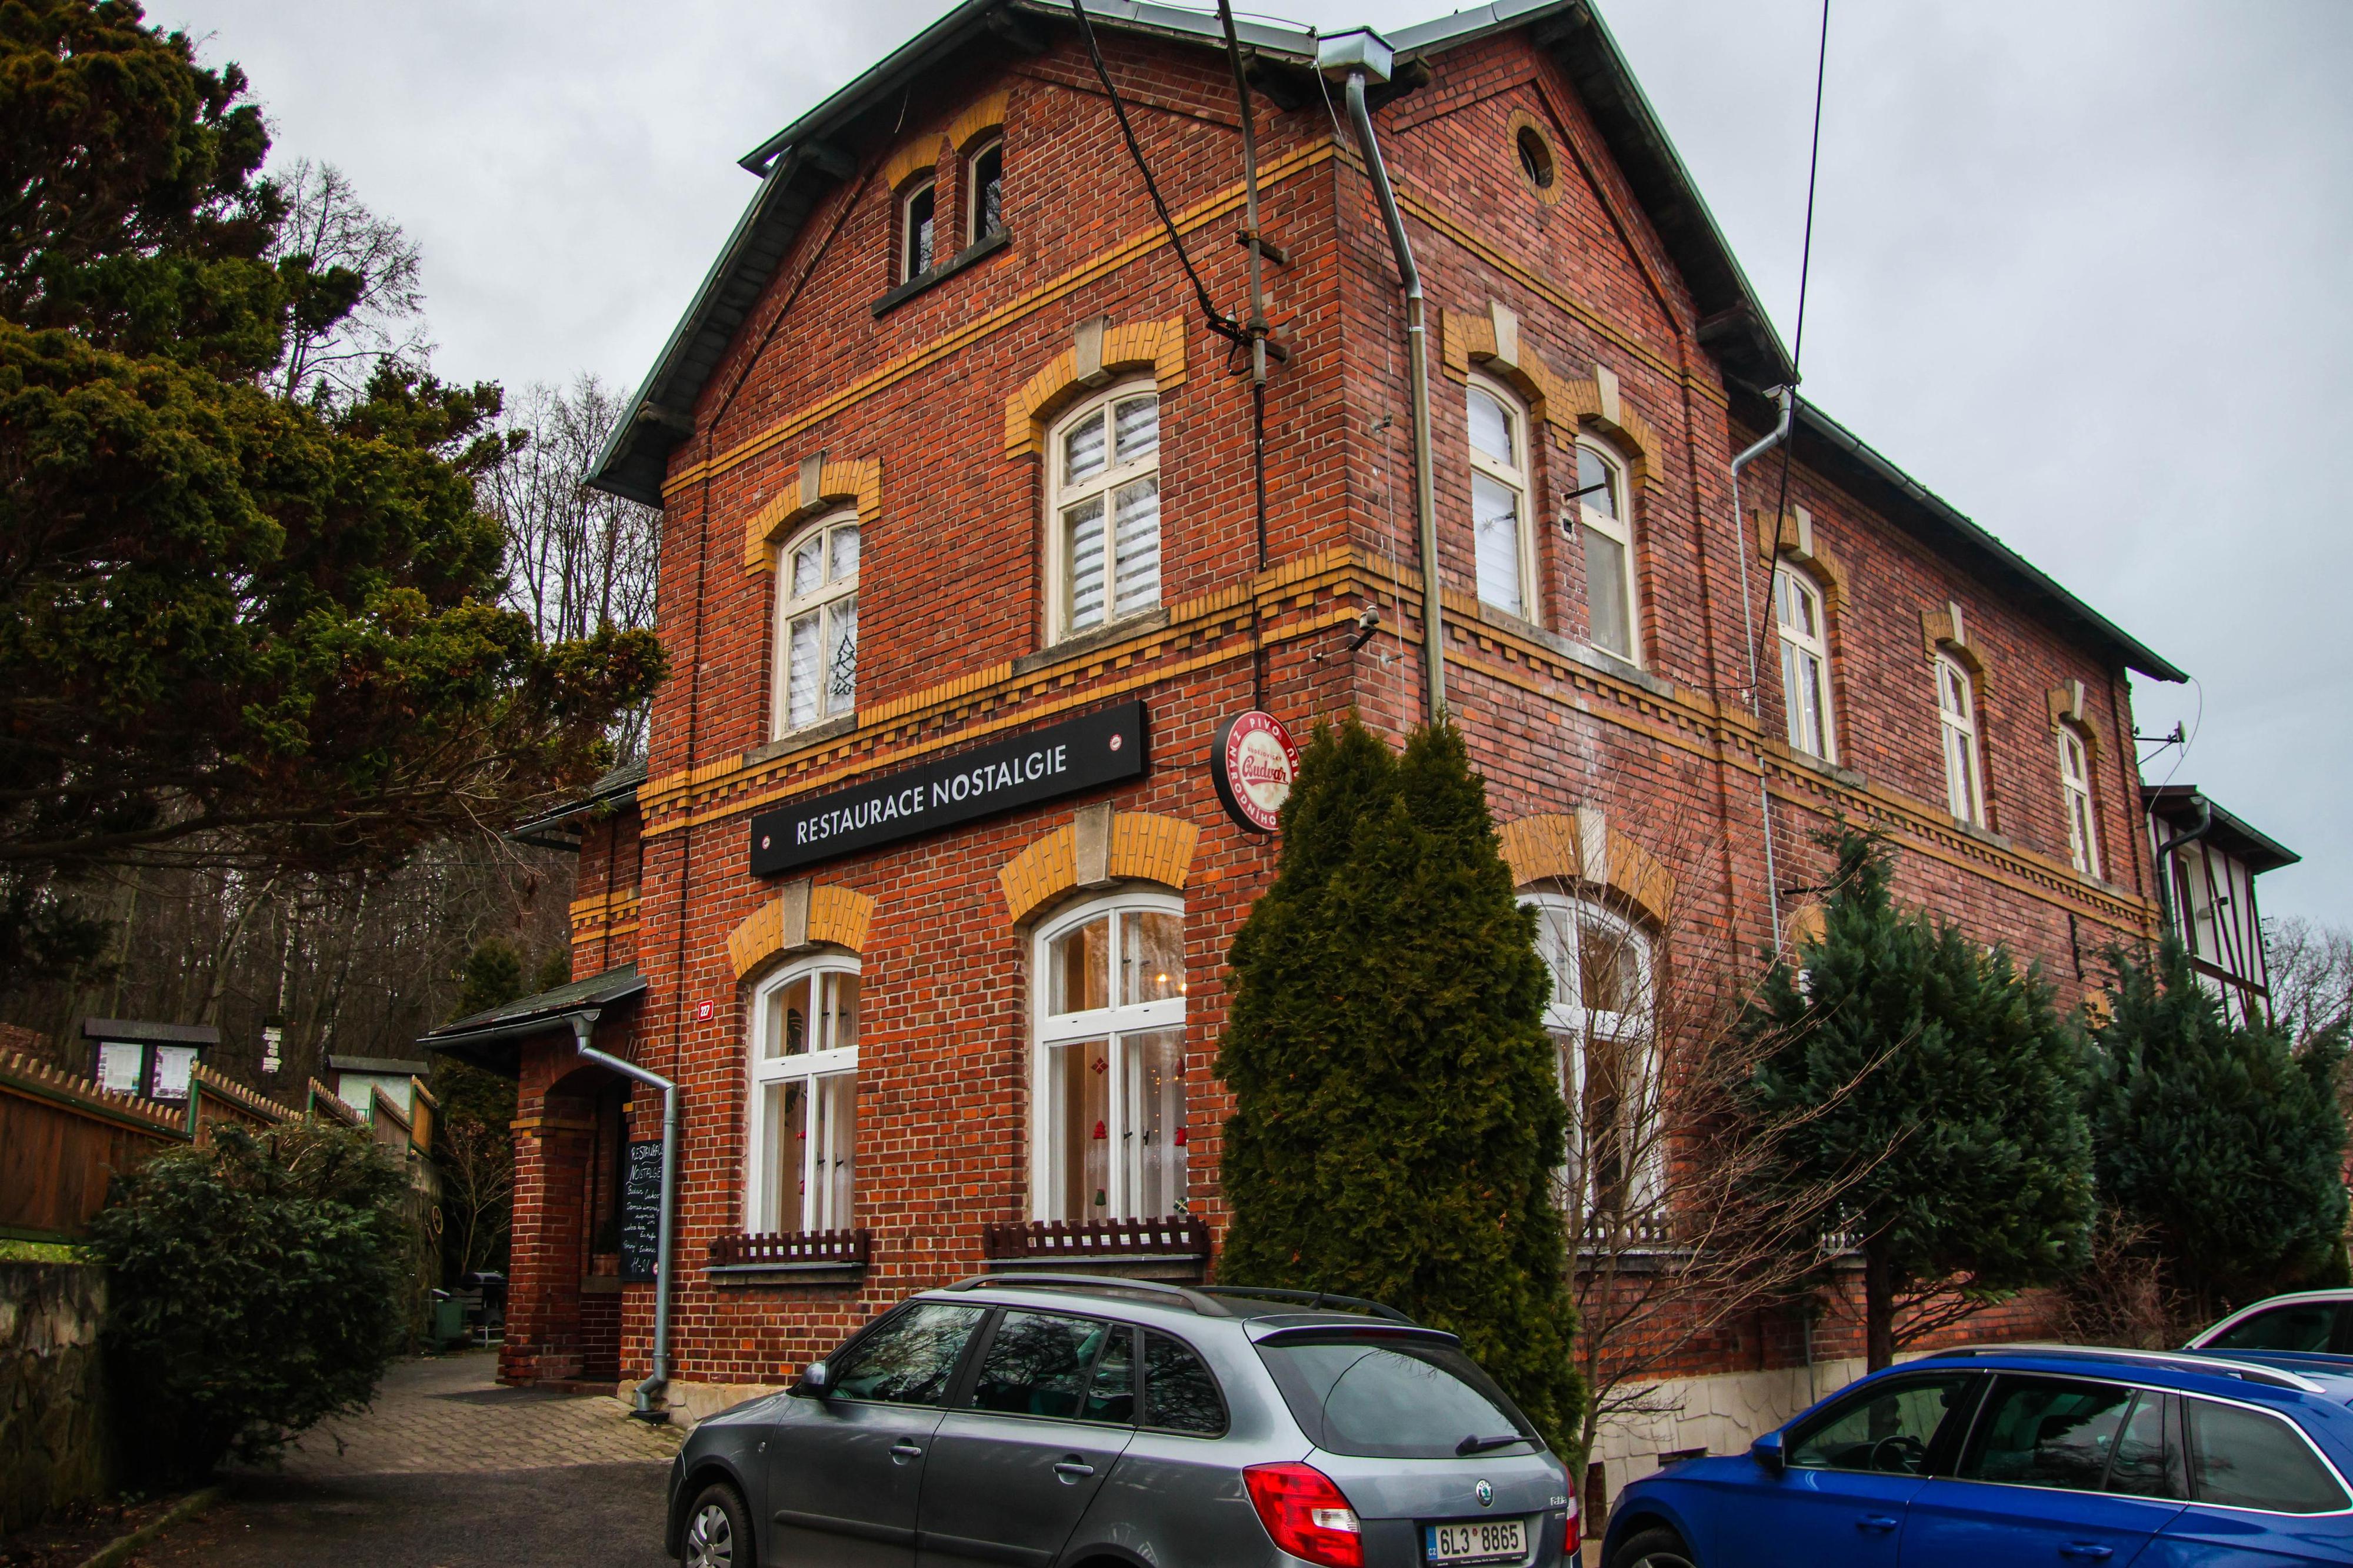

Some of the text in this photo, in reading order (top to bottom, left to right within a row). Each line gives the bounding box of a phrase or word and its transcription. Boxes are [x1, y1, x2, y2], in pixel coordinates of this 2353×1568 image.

[1249, 718, 1279, 736] PIVO
[797, 744, 1067, 845] RESTAURACE NOSTALGIE
[701, 1005, 710, 1017] 227
[1440, 1524, 1519, 1554] 6L3 8865
[1428, 1547, 1437, 1556] CZ
